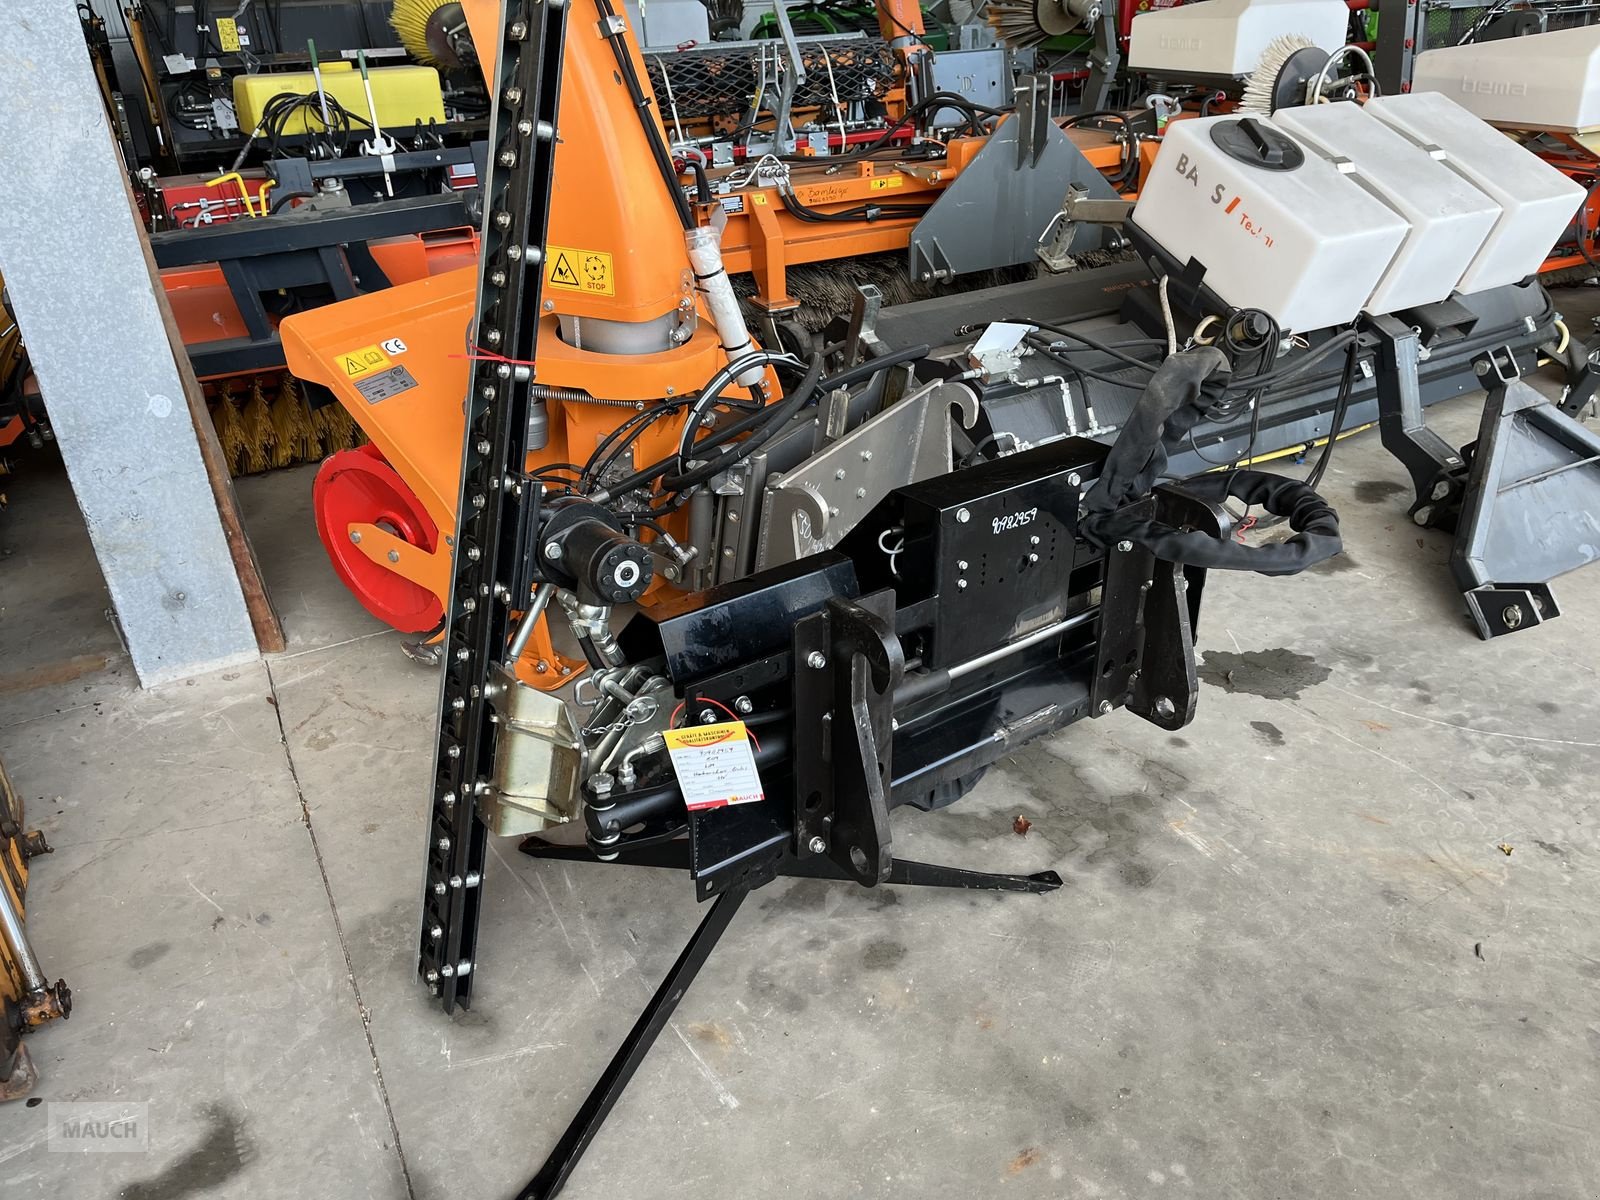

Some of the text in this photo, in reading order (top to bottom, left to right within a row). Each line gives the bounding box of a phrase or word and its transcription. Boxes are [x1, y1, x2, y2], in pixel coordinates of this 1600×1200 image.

[1160, 33, 1202, 51] bema
[1461, 74, 1527, 96] bema
[587, 282, 606, 291] STOP
[385, 339, 405, 353] CE
[992, 507, 1038, 535] 90982959
